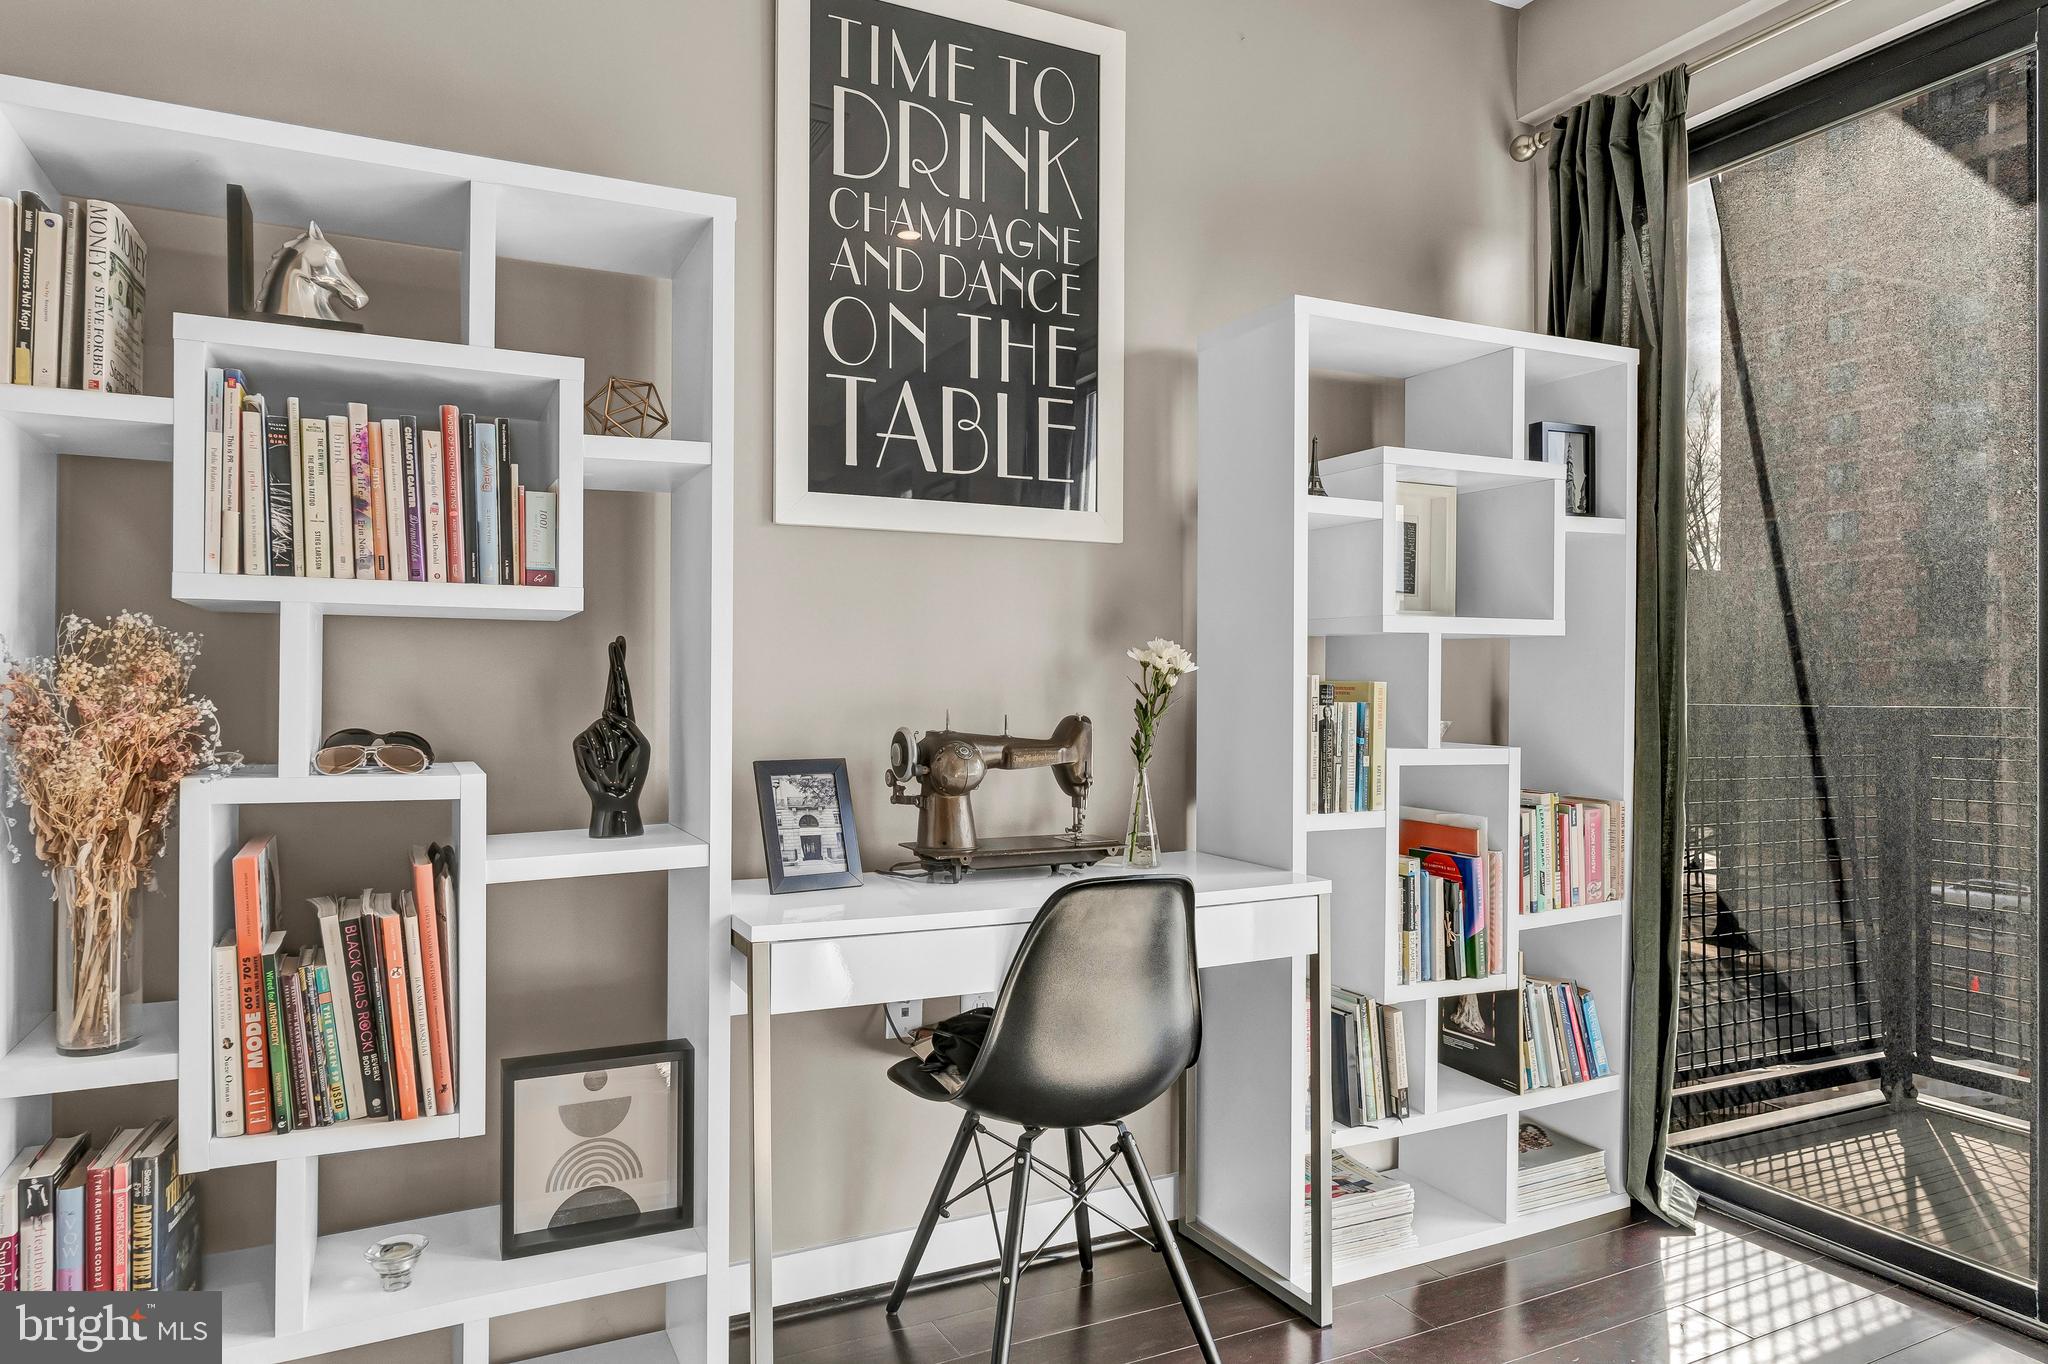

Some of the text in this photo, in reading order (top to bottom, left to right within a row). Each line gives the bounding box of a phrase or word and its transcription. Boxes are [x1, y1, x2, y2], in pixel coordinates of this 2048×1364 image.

[828, 14, 1076, 125] TIME TO
[833, 85, 1083, 219] DRINK
[88, 205, 108, 270] MONEY
[114, 215, 147, 279] MONEY
[829, 188, 1081, 266] CHAMPAGNE
[19, 247, 33, 330] Promises Not Kept
[829, 238, 1081, 316] AND DANCE
[92, 286, 104, 376] STEVE FORBES
[823, 296, 1076, 390] ON THE
[334, 434, 345, 464] blink
[388, 428, 398, 453] cupcakes
[825, 373, 1076, 483] TABLE
[227, 455, 234, 463] PR
[353, 442, 364, 475] perfect
[404, 426, 416, 508] CHARLOTTE CARTER
[447, 414, 457, 509] WORD OF MOUTH MARKETING
[308, 488, 316, 507] TATTOO
[356, 478, 365, 496] life
[357, 520, 367, 564] Erin Noelle
[409, 514, 420, 562] Drumsticks
[539, 510, 547, 528] 1001
[242, 957, 253, 1010] 60'S 70'S
[344, 925, 374, 1053] BLACK GIRLS ROCK!
[266, 970, 279, 1046] Wired for AUTHENTICITY
[323, 1005, 332, 1025] THE
[245, 1012, 264, 1068] MODE
[327, 1027, 337, 1068] BROKEN
[418, 1024, 428, 1057] BASQUIAT
[224, 1055, 233, 1103] Suze Orman
[297, 1060, 307, 1104] SUNGLASSES
[362, 1056, 371, 1076] BOND
[370, 1053, 380, 1082] BEVERLY
[248, 1088, 267, 1124] ELLE
[332, 1086, 344, 1109] USED
[133, 1182, 141, 1197] Fyfe
[143, 1169, 152, 1197] Skolnick
[63, 1217, 80, 1259] VOW
[116, 1195, 125, 1266] WOMEN'S LACROSSE
[133, 1203, 153, 1249] ABOVE
[32, 1229, 48, 1291] Heartbrea
[133, 1250, 152, 1280] THE
